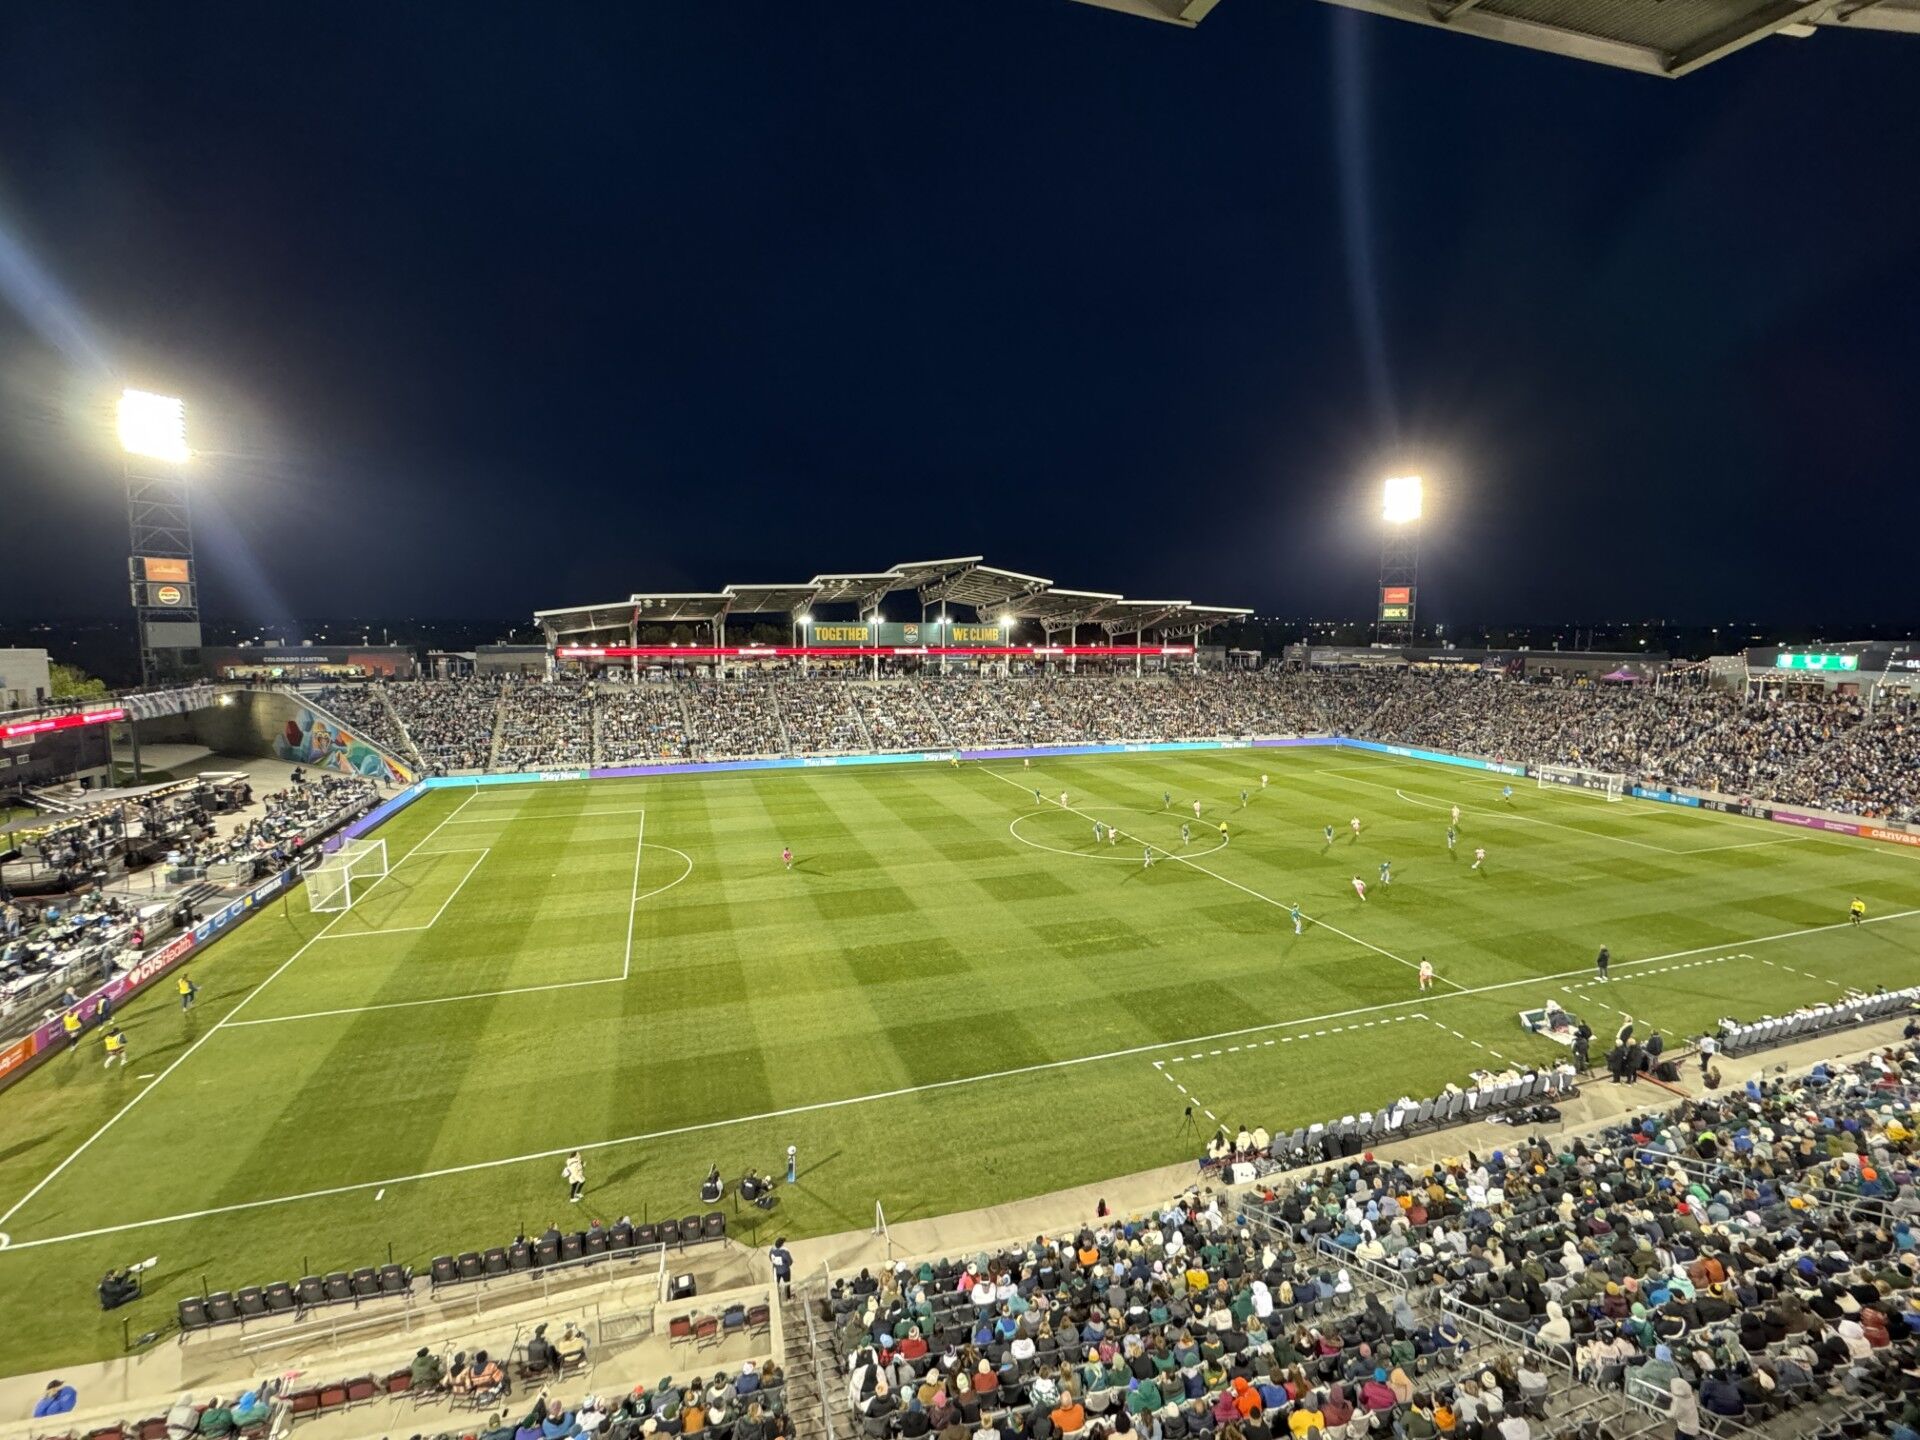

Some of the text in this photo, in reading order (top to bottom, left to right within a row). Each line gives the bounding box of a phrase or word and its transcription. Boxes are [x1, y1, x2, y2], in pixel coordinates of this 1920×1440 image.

[814, 626, 869, 641] TOGETHER
[952, 627, 1000, 641] WE CLIMB
[541, 771, 580, 781] Play Now
[1872, 829, 1917, 843] canvas
[636, 1403, 646, 1415] 10
